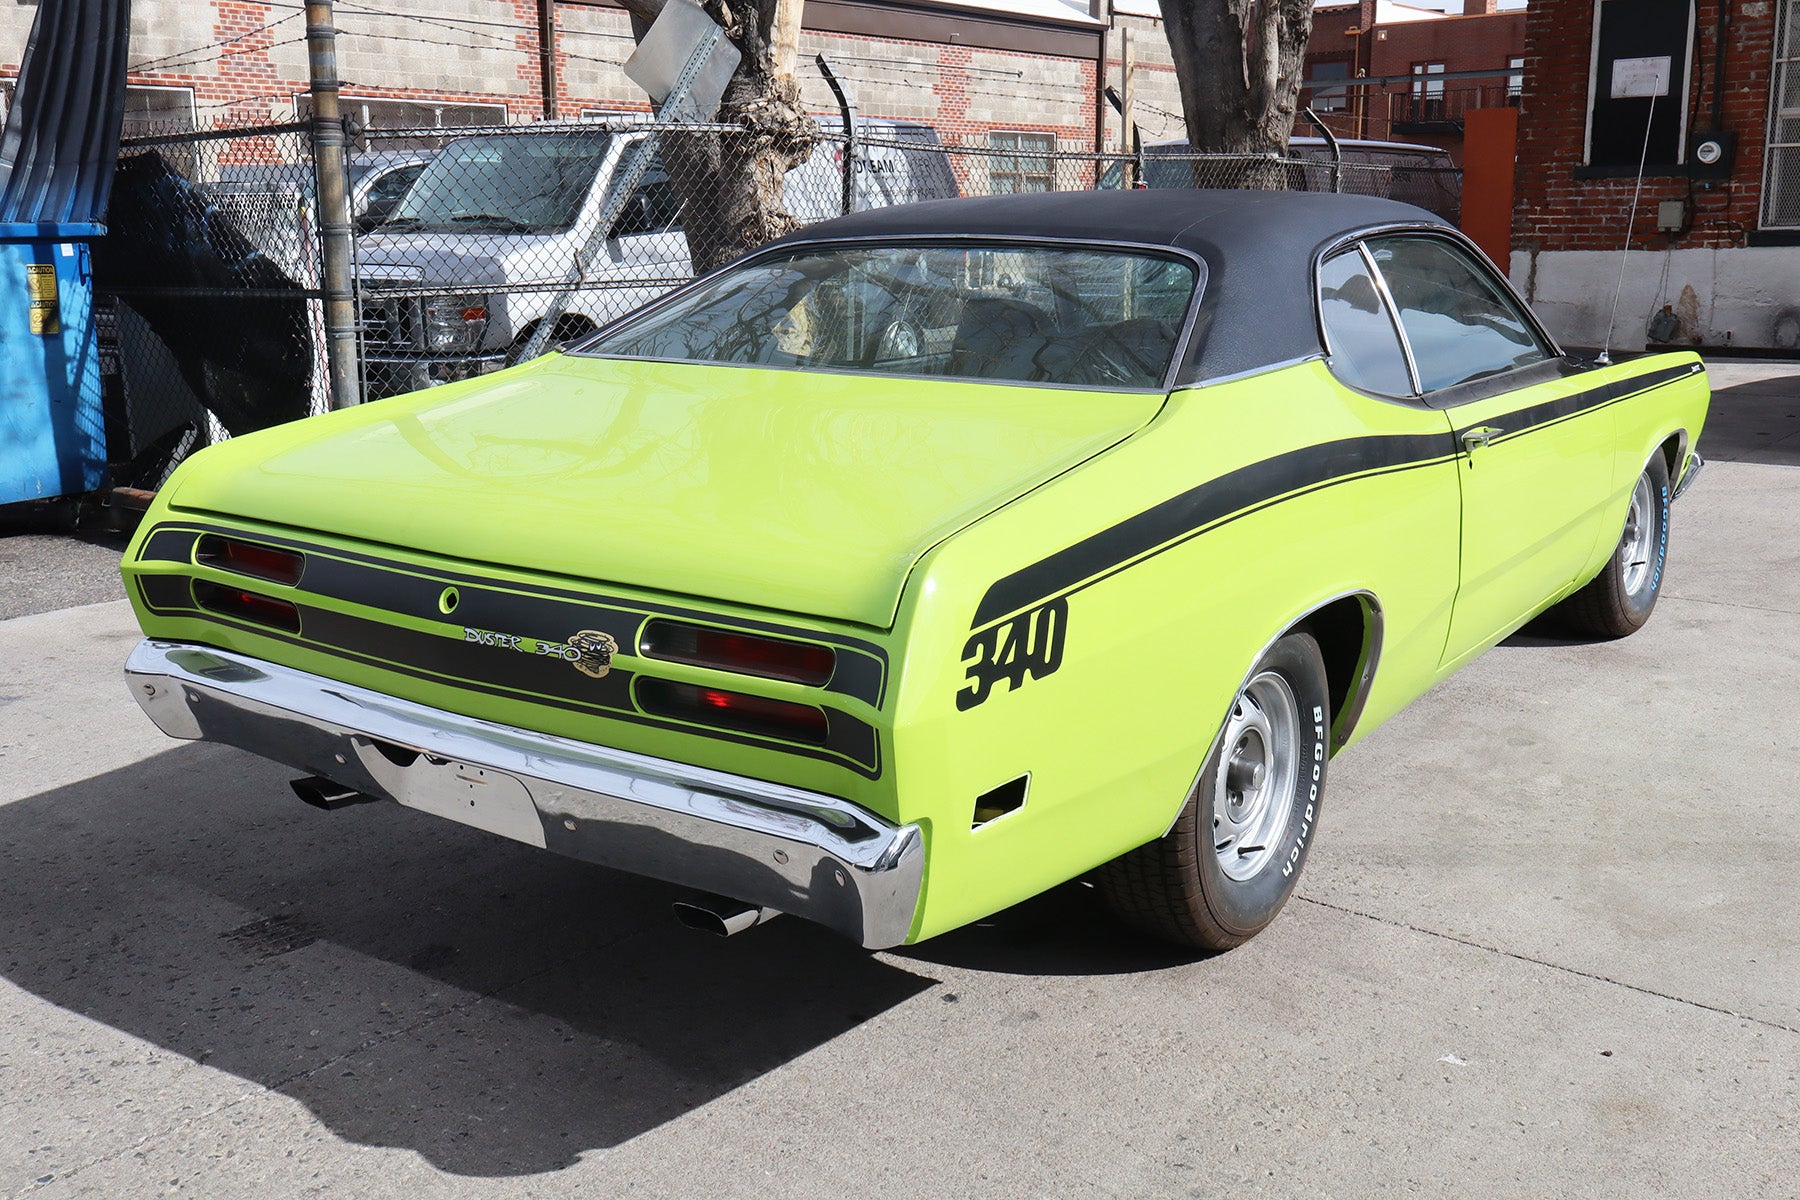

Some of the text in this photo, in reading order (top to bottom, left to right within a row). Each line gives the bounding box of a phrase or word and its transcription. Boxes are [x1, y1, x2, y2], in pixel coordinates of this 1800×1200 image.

[464, 627, 582, 662] DUSTER 340
[955, 597, 1069, 712] 340
[1282, 705, 1323, 877] BFGoodrich
